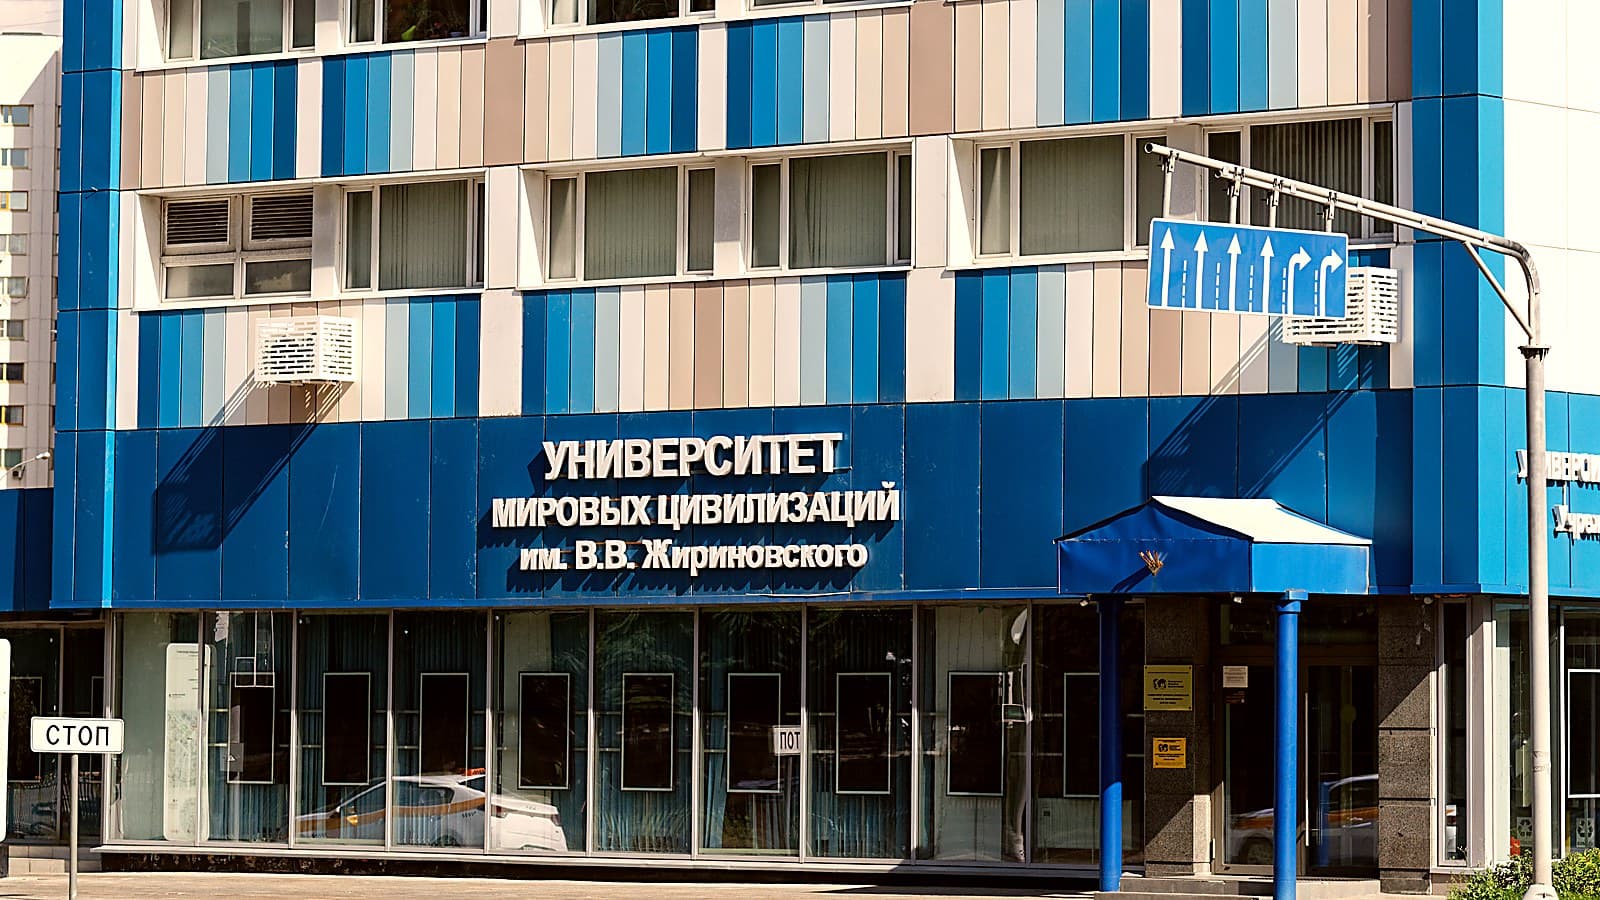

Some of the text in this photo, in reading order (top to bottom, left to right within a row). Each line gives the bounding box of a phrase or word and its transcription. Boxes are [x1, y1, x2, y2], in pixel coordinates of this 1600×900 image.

[542, 433, 843, 480] УНИВЕРСИТЕТ
[492, 481, 901, 530] МИРОВЫХ ЦИВИЛИЗАЦИЙ
[519, 538, 868, 577] им. В.В. Жириновского
[46, 724, 109, 746] СТОП
